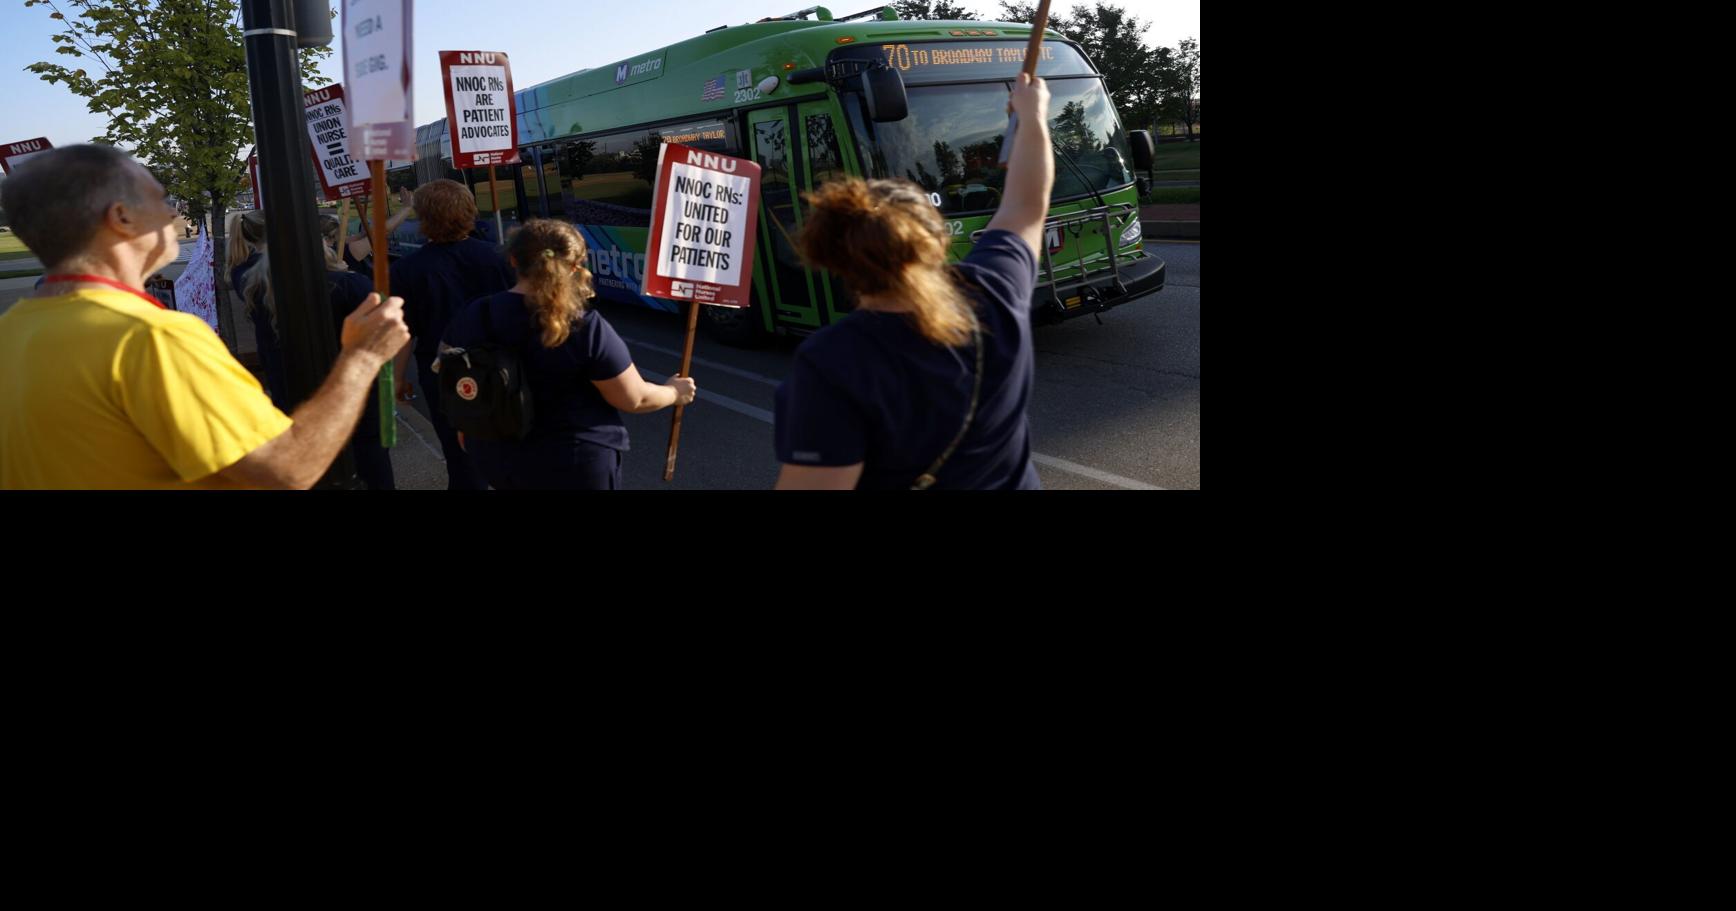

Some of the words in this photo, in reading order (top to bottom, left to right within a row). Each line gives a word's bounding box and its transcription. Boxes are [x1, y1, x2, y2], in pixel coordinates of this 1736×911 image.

[460, 53, 496, 64] NNU
[882, 44, 911, 71] 70
[911, 50, 928, 65] TO
[931, 49, 992, 65] BROADWAY
[996, 47, 1029, 63] TAYL
[631, 58, 661, 76] metro
[456, 76, 487, 91] NNOC
[488, 76, 504, 91] RNs
[475, 94, 494, 105] ARE
[734, 88, 761, 103] 2302
[324, 104, 342, 116] RNs
[463, 109, 505, 122] PATIENT
[313, 117, 341, 133] UNION
[461, 125, 510, 139] ADVOCATES
[317, 128, 347, 144] NURSE
[10, 140, 42, 154] NNU
[324, 154, 360, 171] QUALIT
[687, 150, 737, 172] NNU
[334, 165, 358, 179] CARE
[675, 176, 711, 198] NNOC
[715, 185, 743, 205] RNs:
[684, 201, 729, 224] UNITED
[675, 222, 700, 243] FOR
[704, 227, 732, 248] OUR
[670, 245, 730, 270] PATIENTS
